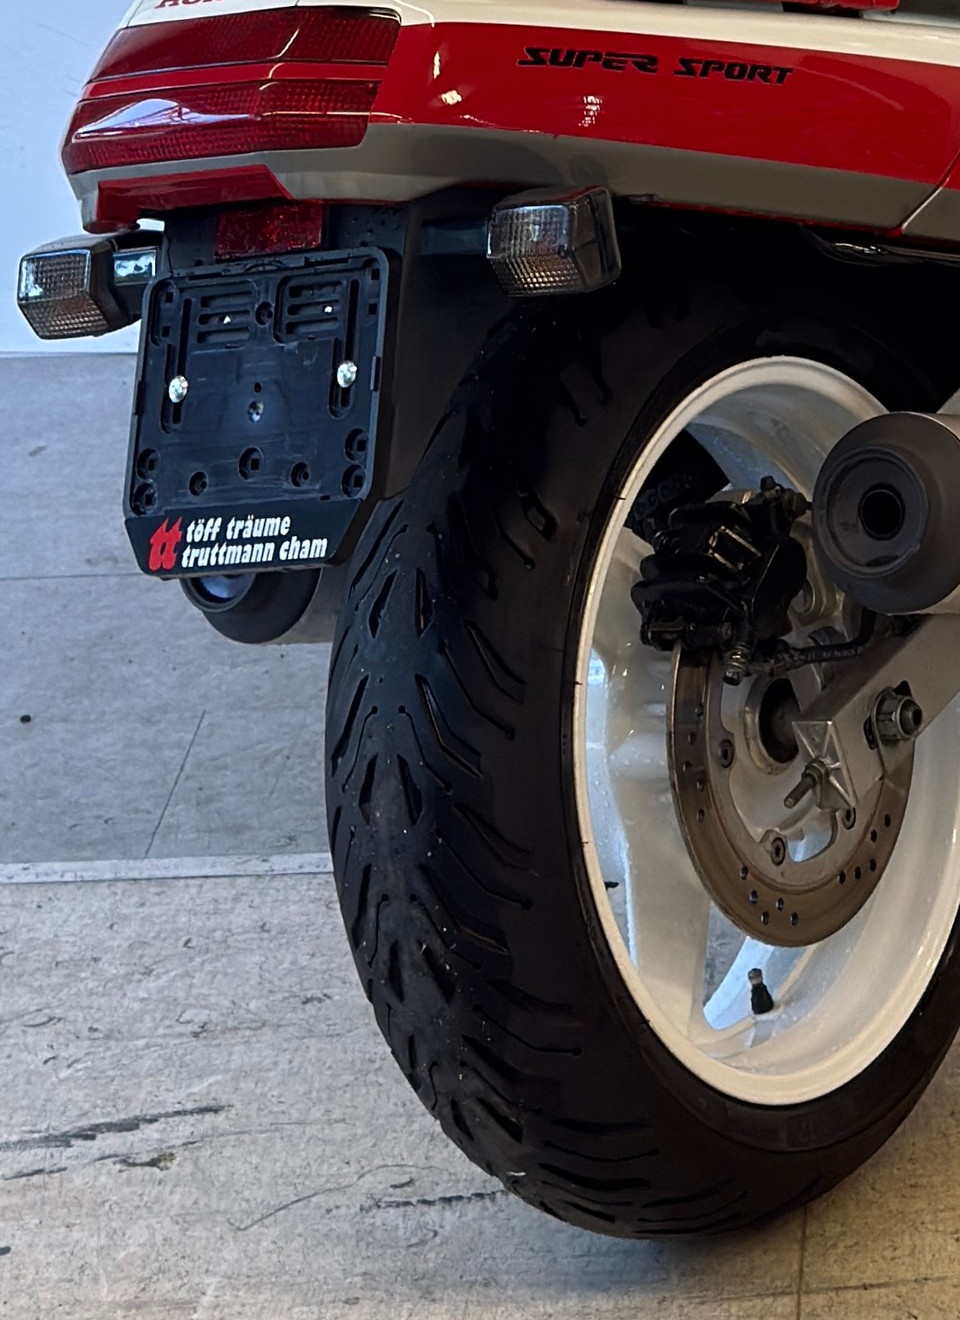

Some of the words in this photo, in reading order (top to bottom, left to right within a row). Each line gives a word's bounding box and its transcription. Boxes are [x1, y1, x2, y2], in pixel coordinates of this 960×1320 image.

[516, 46, 659, 74] SUPER
[672, 57, 794, 85] SPORT
[186, 517, 222, 543] töff
[226, 515, 291, 540] träume
[181, 541, 275, 568] truttmann
[278, 536, 328, 561] cham
